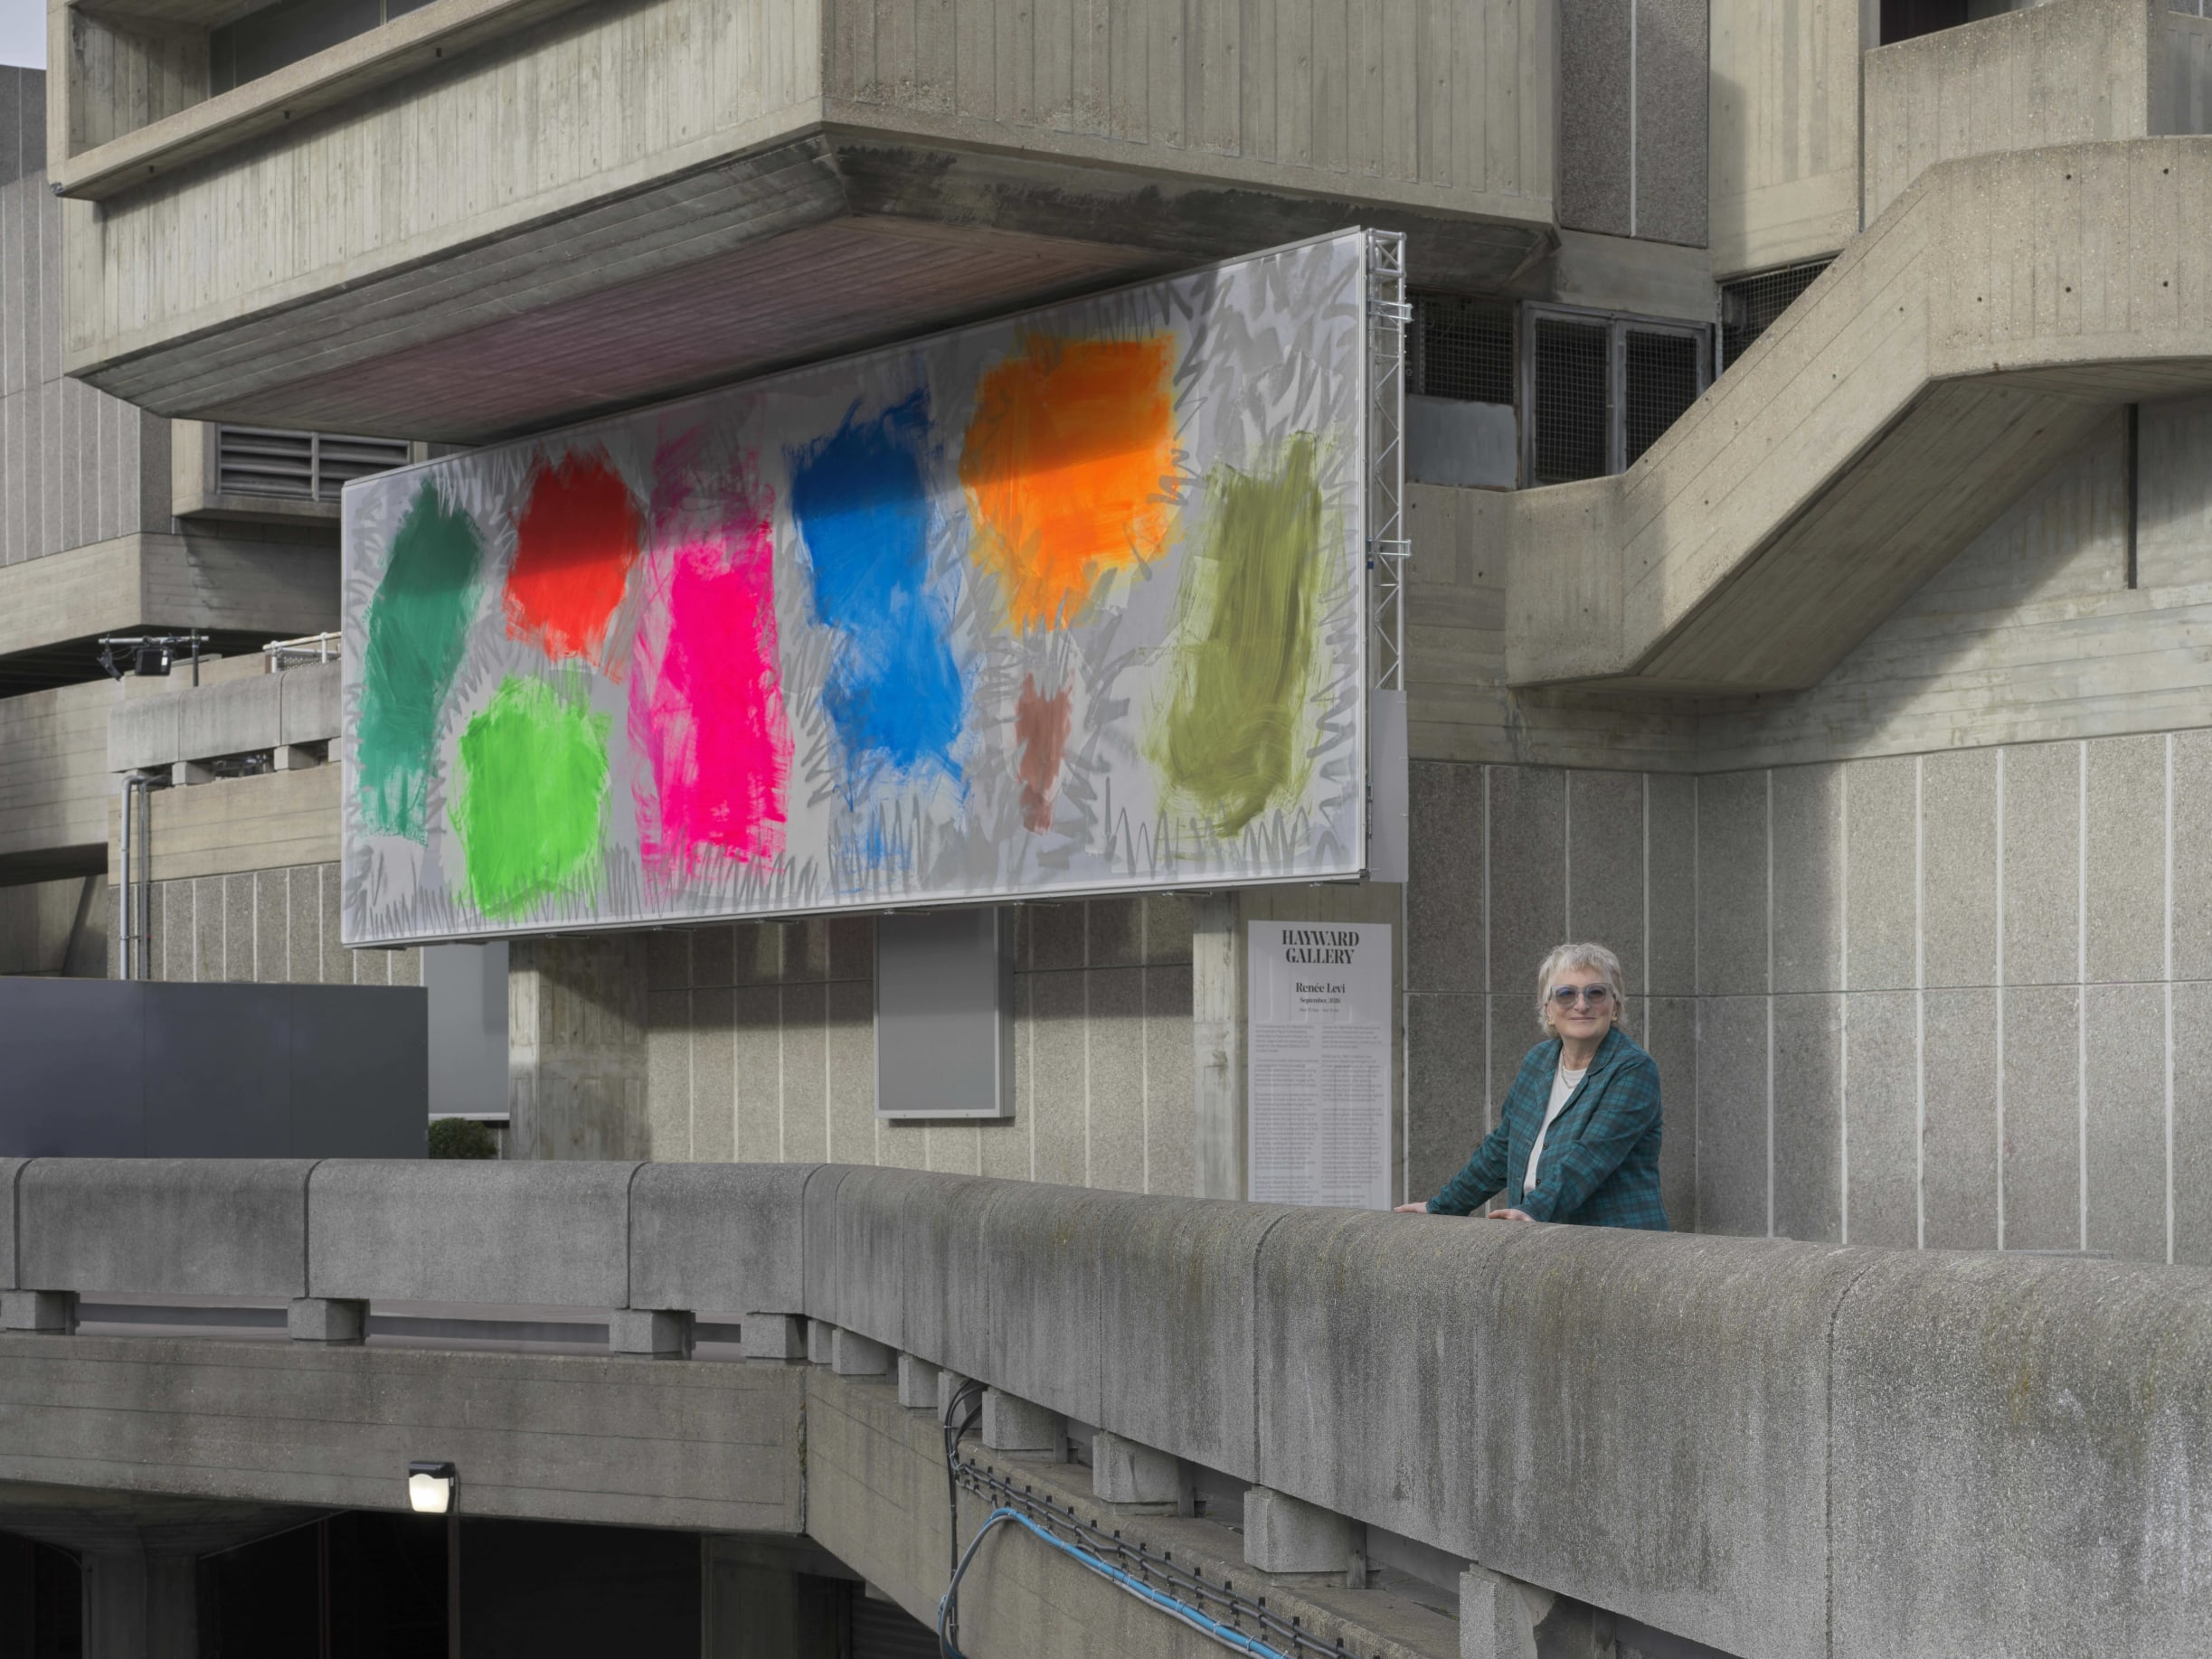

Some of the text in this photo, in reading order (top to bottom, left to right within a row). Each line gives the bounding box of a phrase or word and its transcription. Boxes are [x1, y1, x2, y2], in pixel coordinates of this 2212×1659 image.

[1282, 929, 1360, 947] HAYWARD
[1286, 947, 1355, 965] GALLERY
[1296, 982, 1346, 994] Renée Levi
